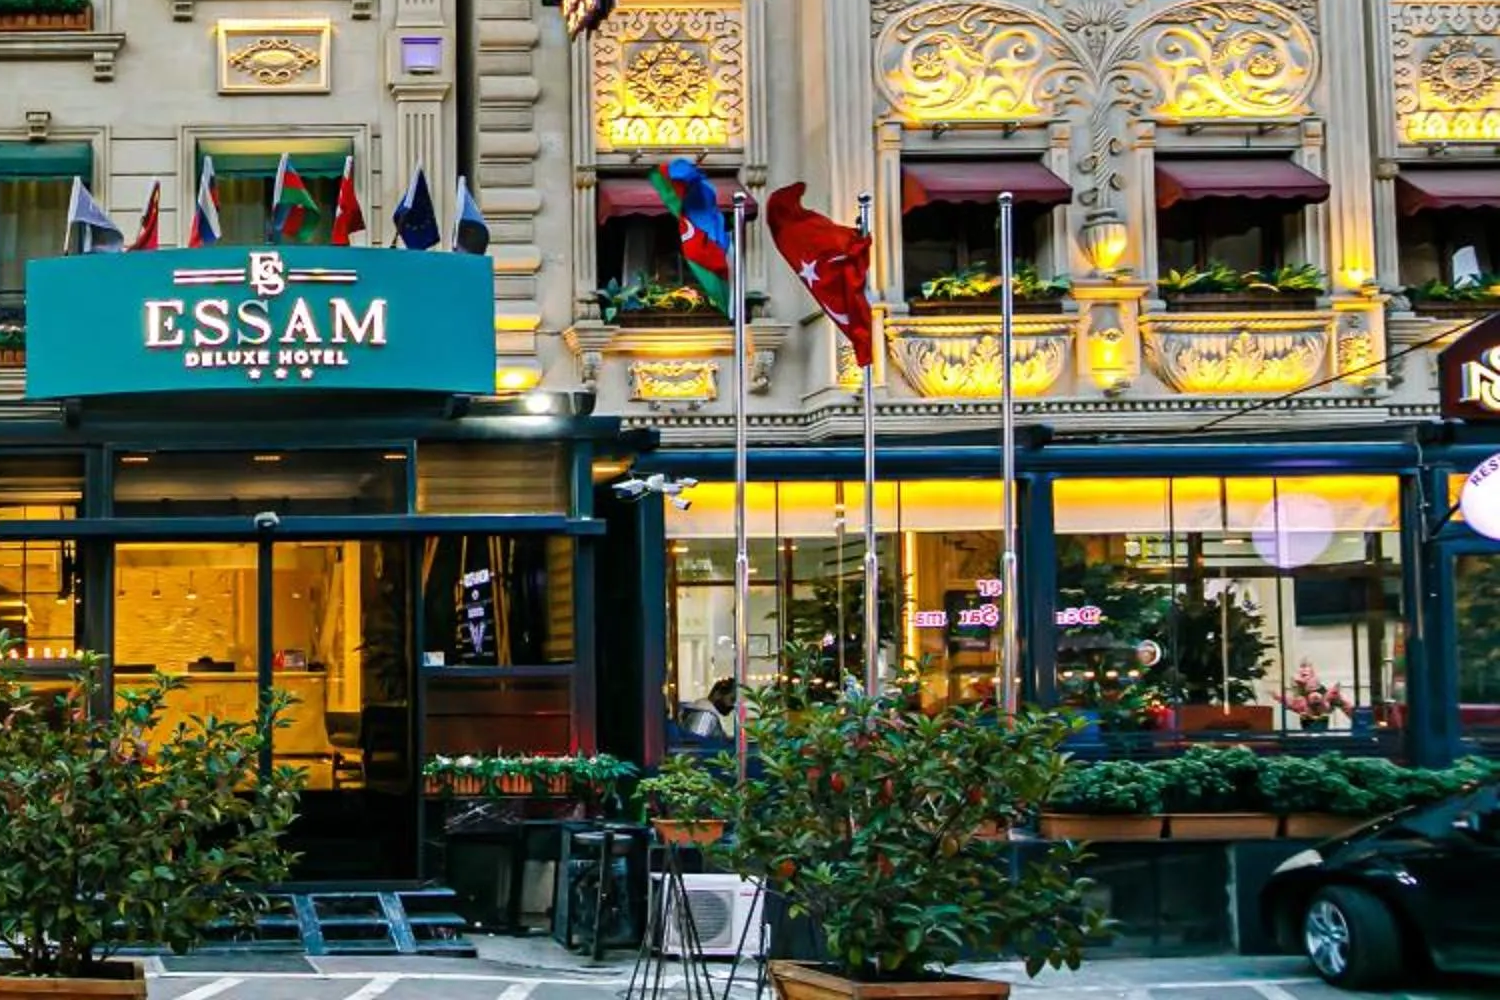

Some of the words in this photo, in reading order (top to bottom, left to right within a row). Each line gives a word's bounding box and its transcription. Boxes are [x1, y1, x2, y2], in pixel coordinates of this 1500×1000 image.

[143, 298, 388, 348] ESSAM
[184, 350, 270, 368] DELUXE
[278, 350, 349, 366] HOTEL
[1470, 456, 1500, 487] RES
